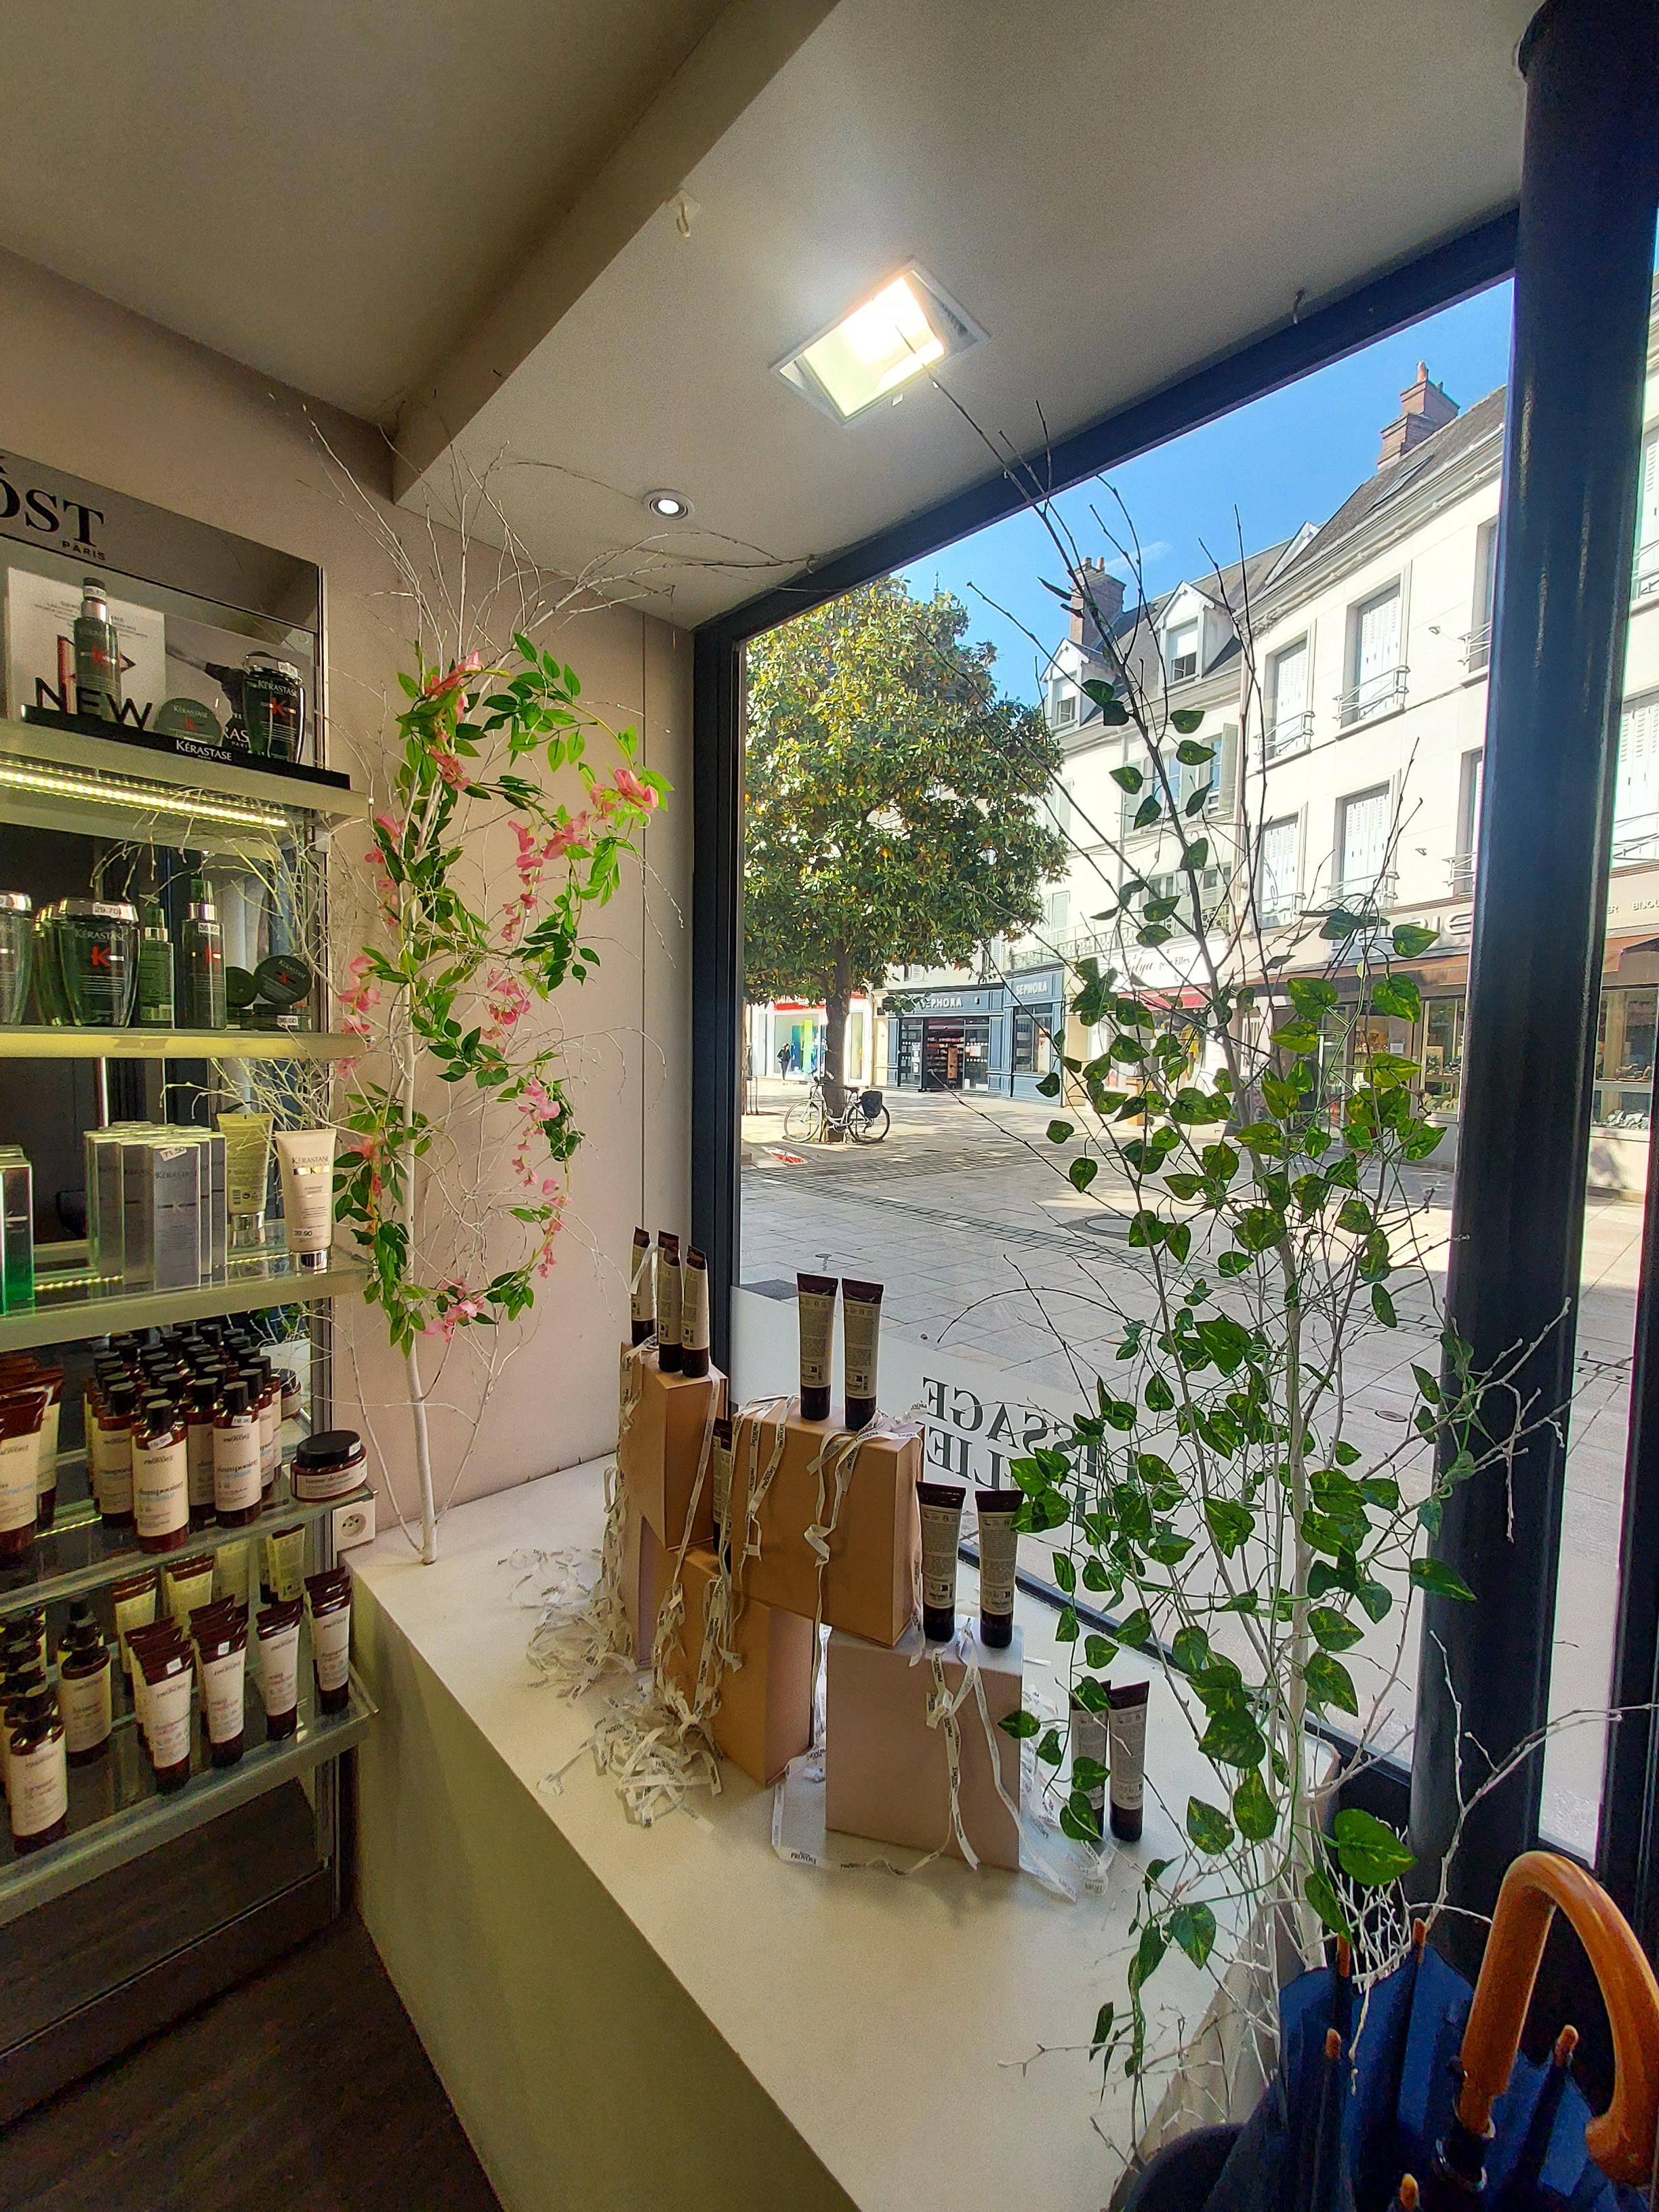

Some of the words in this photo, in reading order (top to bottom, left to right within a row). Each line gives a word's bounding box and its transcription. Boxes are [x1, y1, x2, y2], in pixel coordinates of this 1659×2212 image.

[62, 541, 106, 560] PARIS
[35, 677, 152, 730] NEW
[176, 739, 232, 761] KÉRASTASE
[95, 906, 119, 915] 29.70
[1016, 981, 1048, 996] SEPHORA
